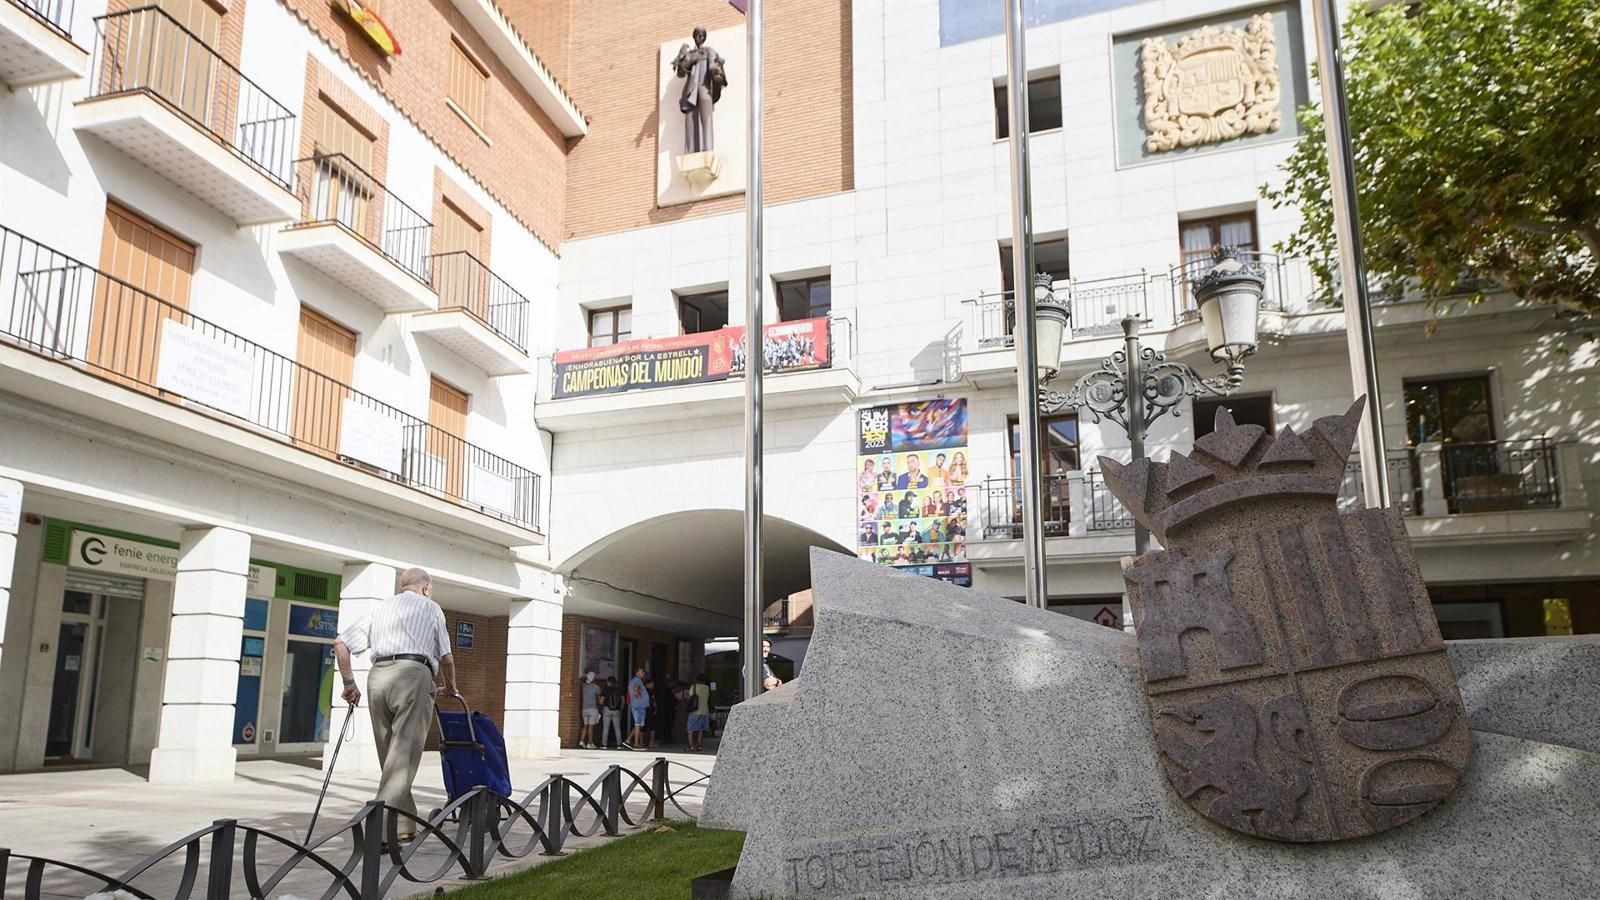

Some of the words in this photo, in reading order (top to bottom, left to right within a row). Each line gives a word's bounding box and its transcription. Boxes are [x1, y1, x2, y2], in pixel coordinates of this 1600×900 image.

[625, 354, 642, 362] POR
[644, 353, 655, 361] LA
[562, 364, 629, 393] CAMPEONAS
[630, 361, 652, 384] DEL
[654, 355, 703, 382] MUNDO!
[861, 410, 889, 422] SUM
[861, 420, 889, 434] MER
[865, 439, 886, 449] 2023
[113, 543, 143, 560] fenie
[146, 552, 178, 569] energ
[969, 831, 1021, 876] DE
[1028, 814, 1164, 873] ARDOZ
